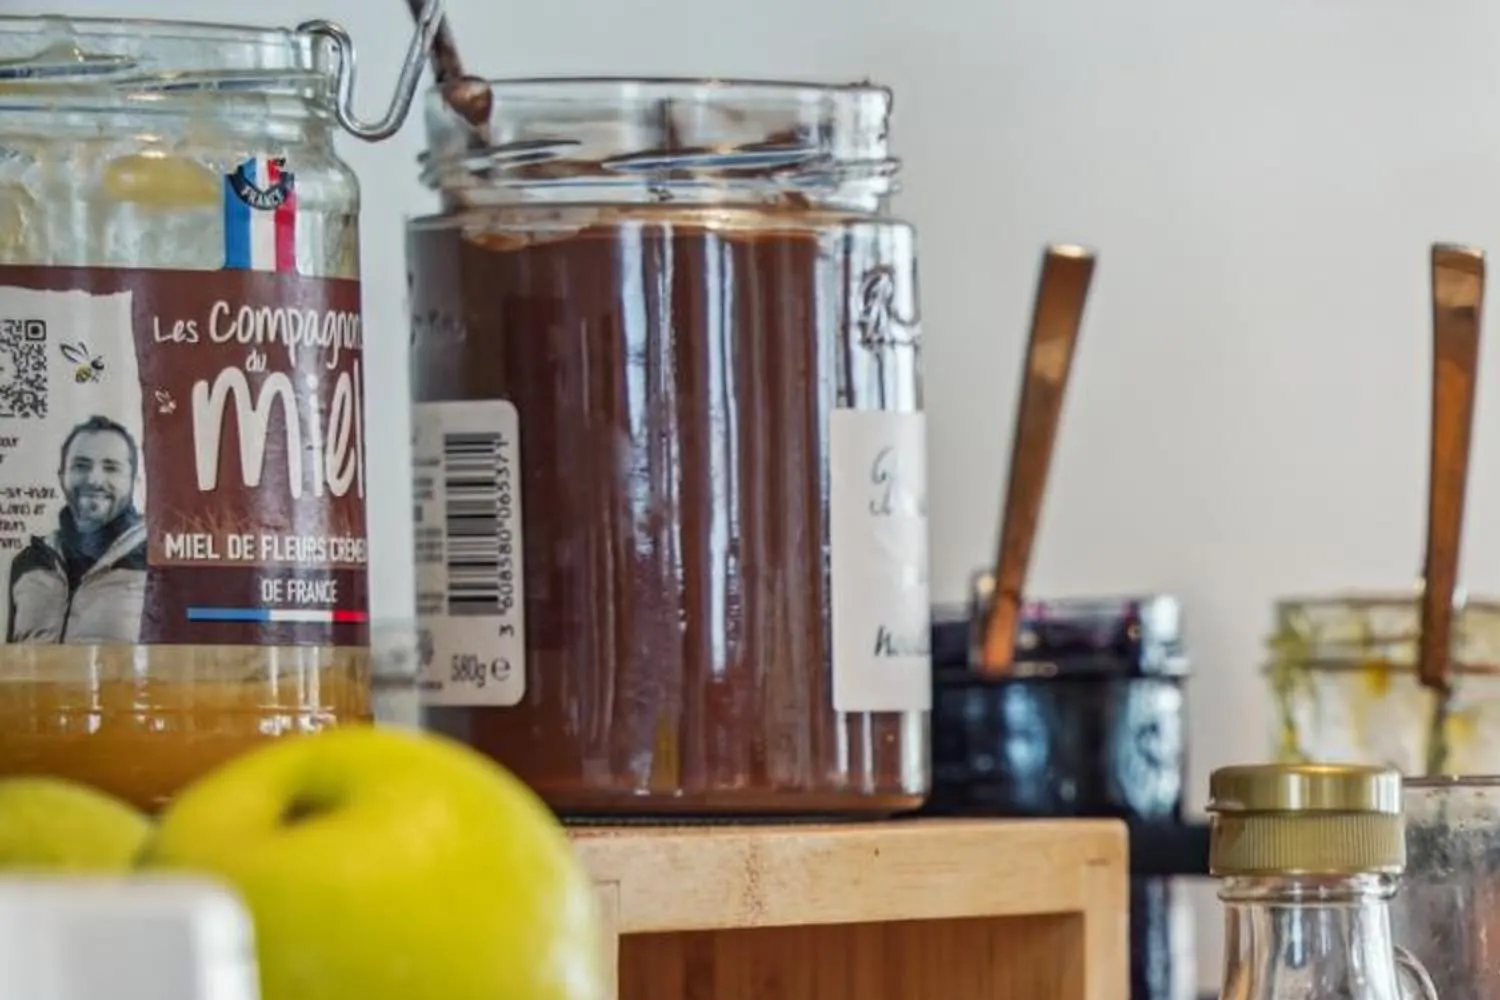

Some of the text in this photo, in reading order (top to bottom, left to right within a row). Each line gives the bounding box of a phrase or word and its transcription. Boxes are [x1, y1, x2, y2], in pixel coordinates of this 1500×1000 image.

[153, 315, 199, 343] Les
[245, 348, 267, 373] du
[165, 533, 220, 560] MIEL
[227, 534, 254, 560] DE
[261, 535, 327, 562] FLEURS
[261, 578, 338, 603] DE FRANCE
